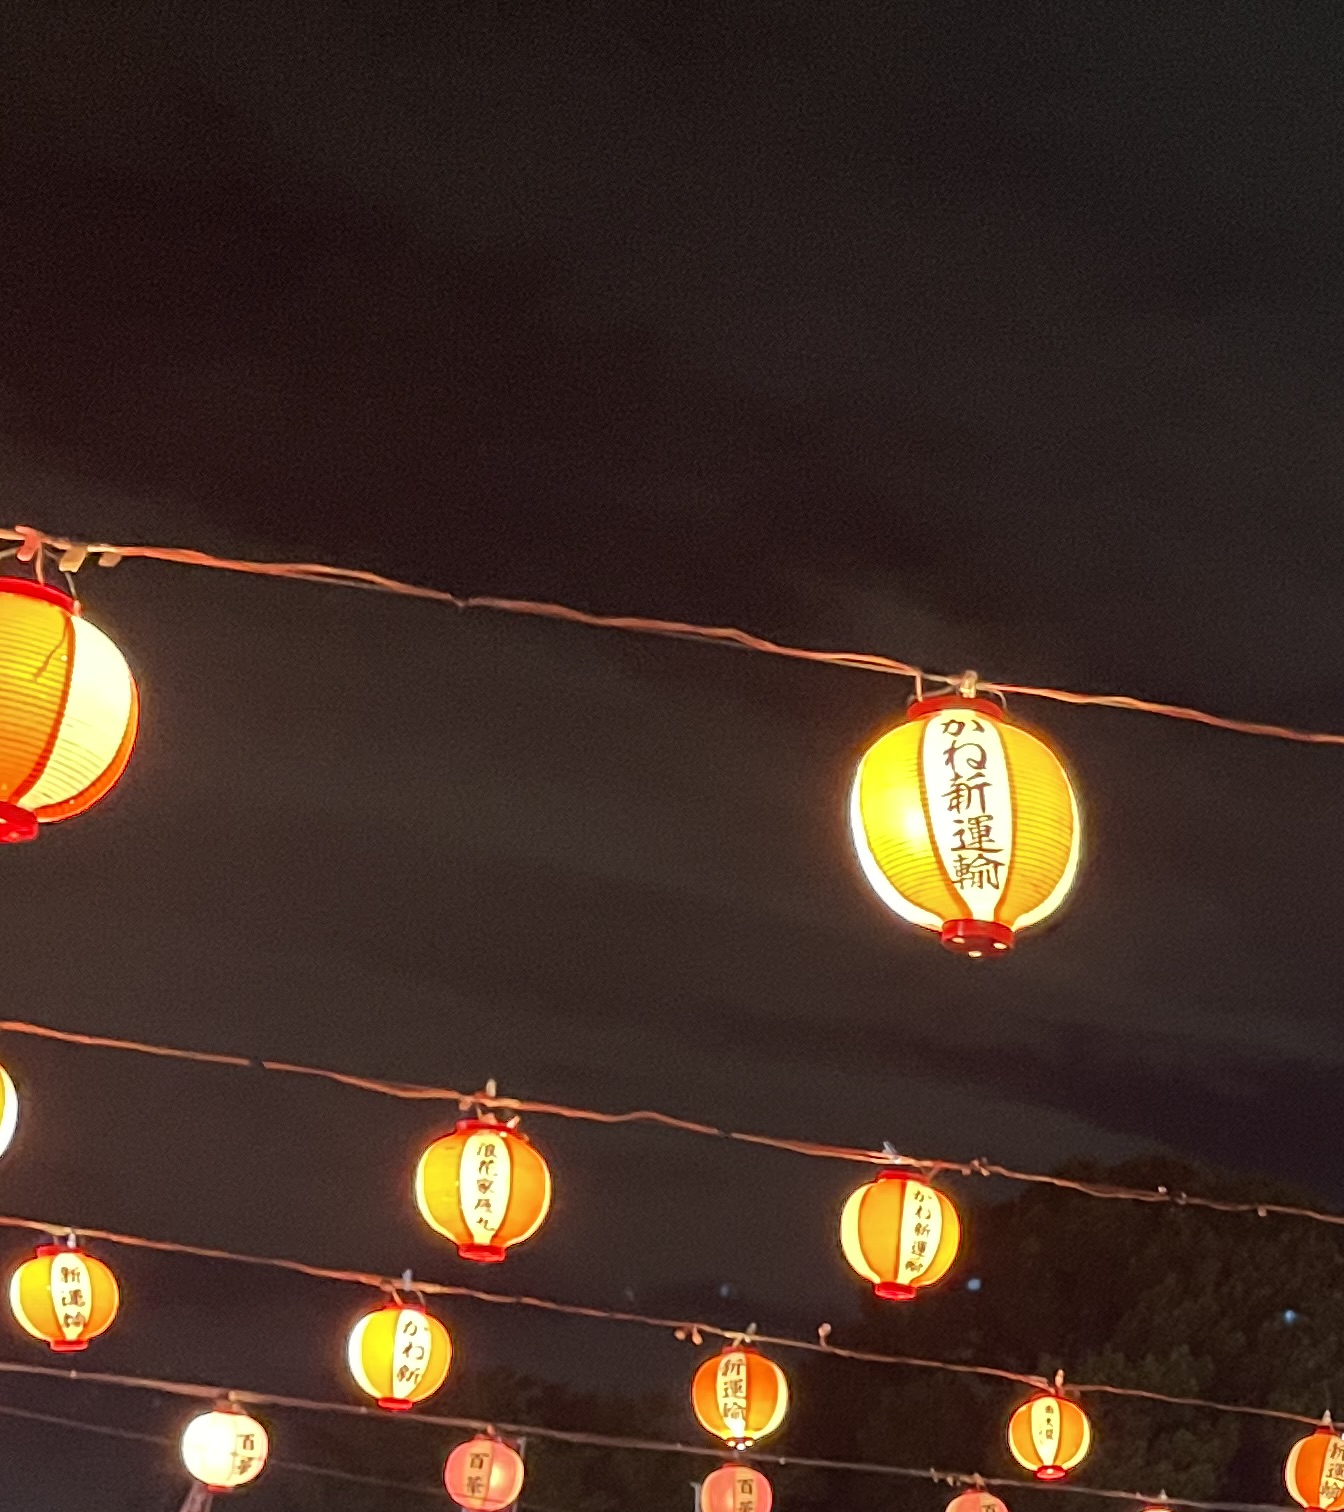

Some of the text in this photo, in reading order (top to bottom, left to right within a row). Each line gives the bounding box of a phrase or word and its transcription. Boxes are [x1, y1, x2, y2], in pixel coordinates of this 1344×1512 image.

[940, 718, 1006, 891] かね新運輸
